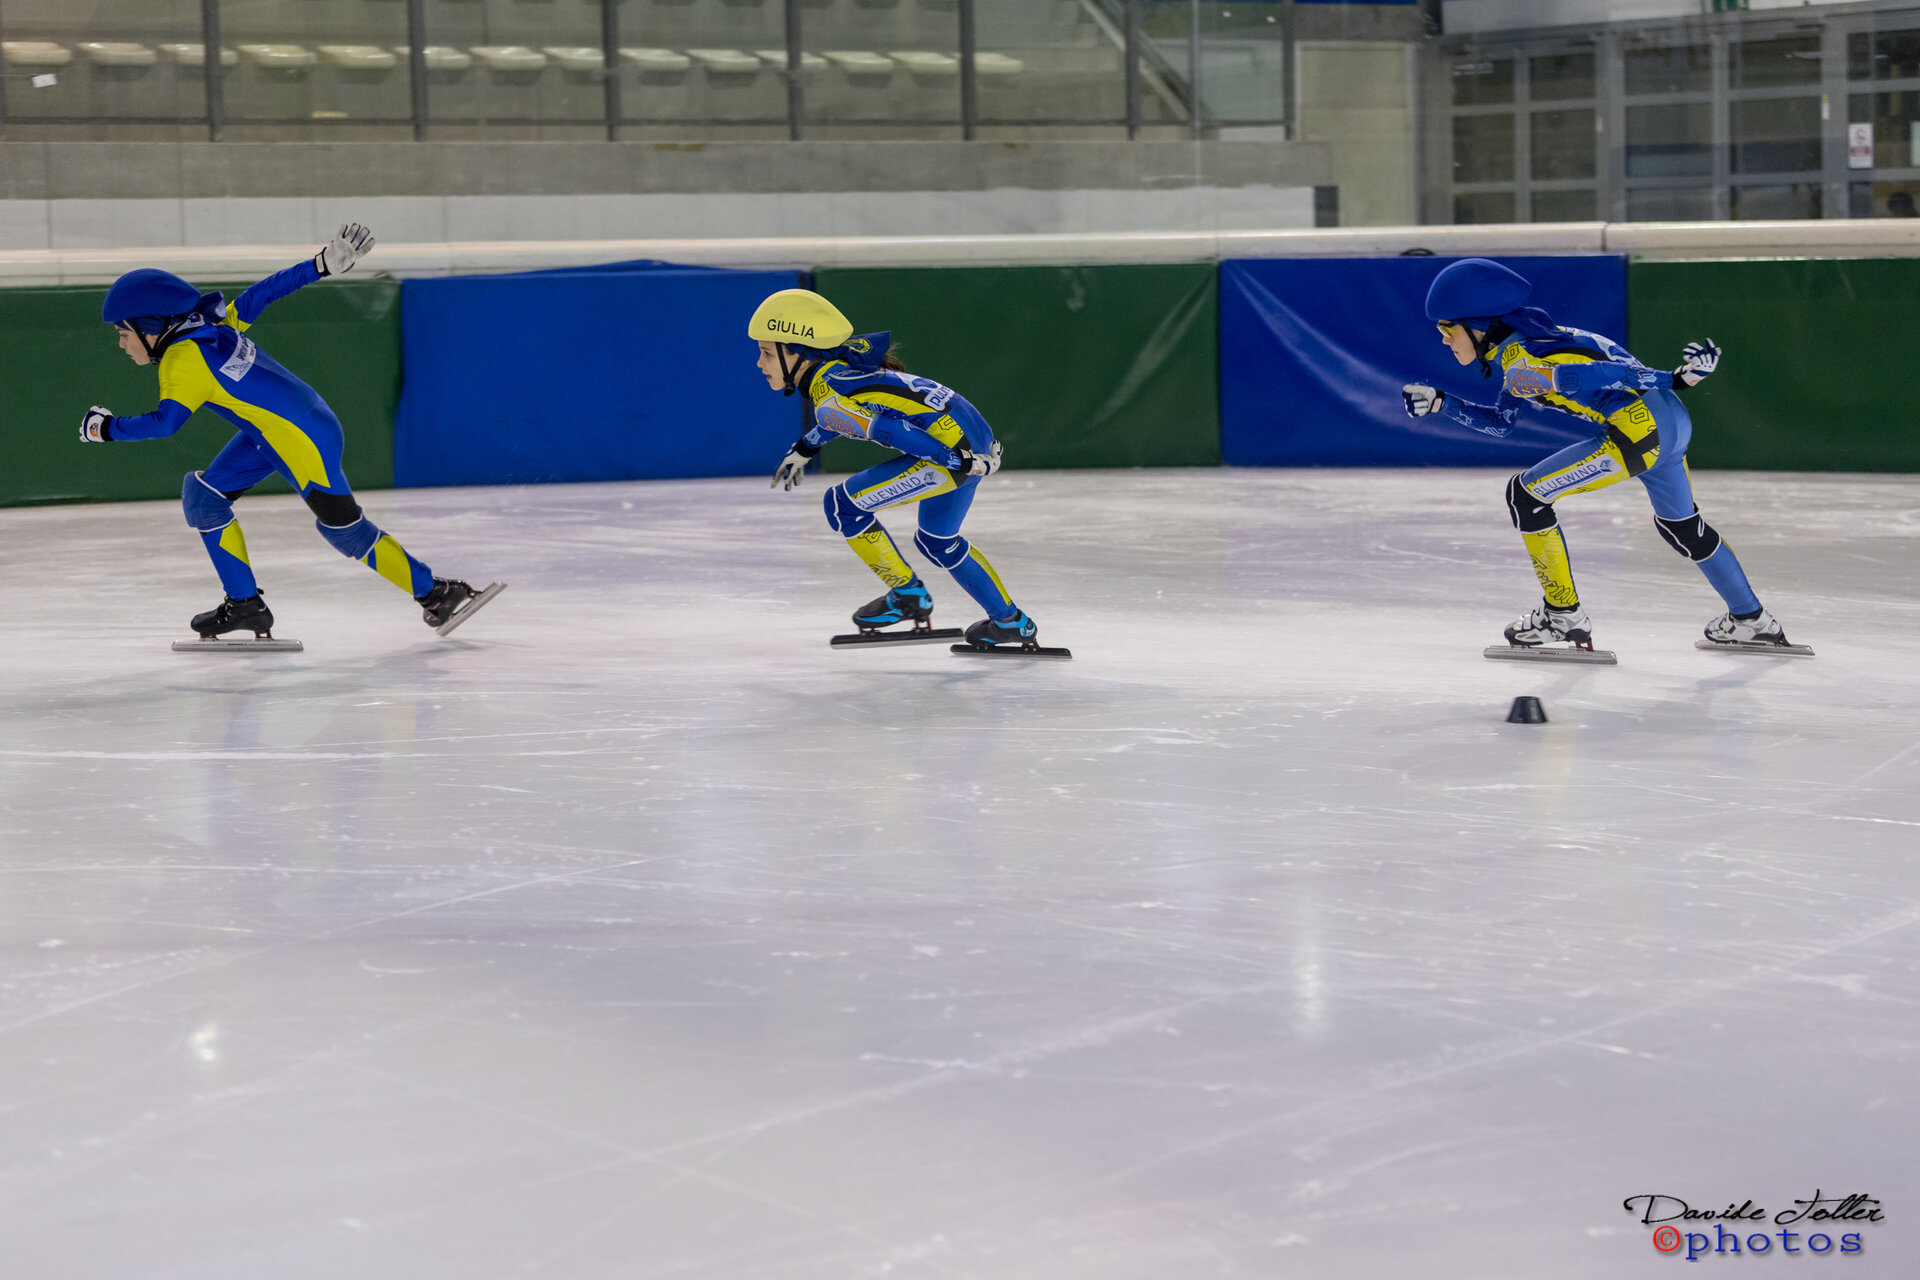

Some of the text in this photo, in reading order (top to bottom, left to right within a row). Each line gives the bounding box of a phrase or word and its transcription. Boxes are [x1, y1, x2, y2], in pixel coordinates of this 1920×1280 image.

[767, 319, 815, 339] GIULIA
[856, 476, 922, 508] BLUEWIND
[1533, 464, 1598, 495] BLUEWIND
